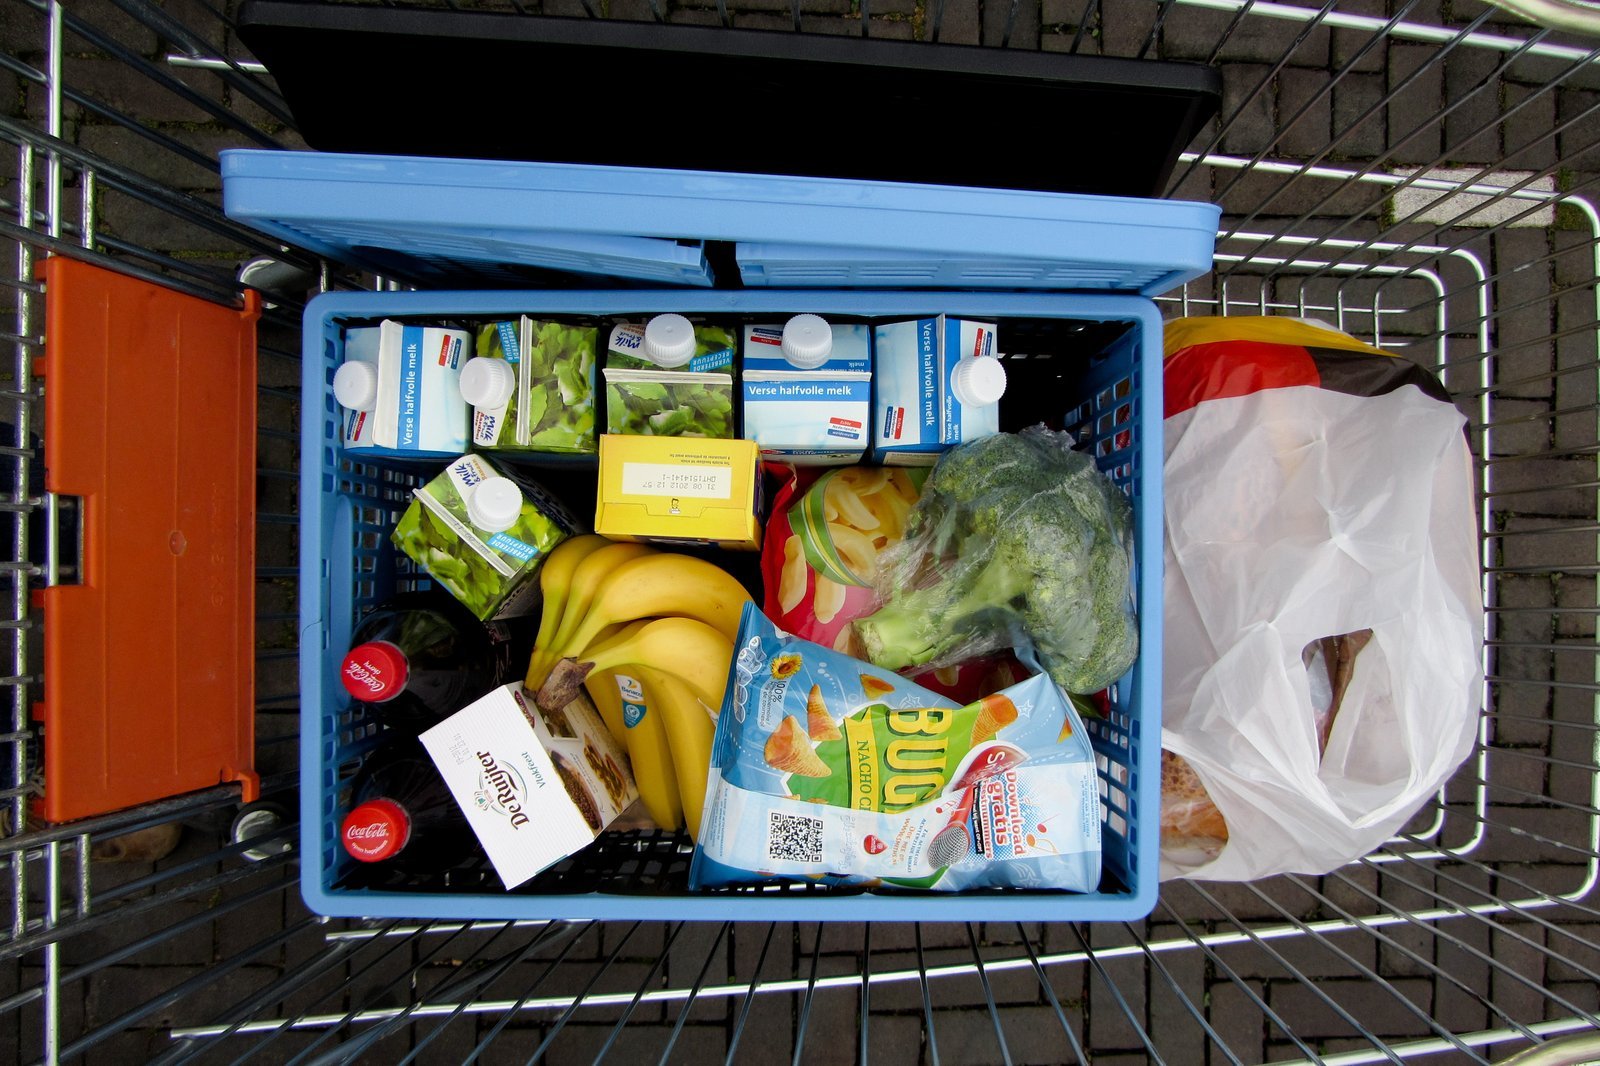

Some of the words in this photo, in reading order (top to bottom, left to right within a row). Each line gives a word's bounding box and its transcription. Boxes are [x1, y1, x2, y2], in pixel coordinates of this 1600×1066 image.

[500, 324, 513, 361] RECEPTUUR
[505, 323, 520, 360] VERBETERDE
[614, 336, 640, 349] Milk
[619, 331, 637, 340] fruit
[923, 323, 931, 352] Verse
[408, 343, 416, 371] melk
[692, 352, 730, 365] RECEPTUUR
[693, 358, 730, 372] VERBETERDE
[924, 353, 934, 396] halfvolle
[405, 372, 416, 414] halfvolle
[749, 386, 777, 396] Verse
[780, 386, 823, 396] halfvolle
[826, 386, 852, 396] melk
[926, 398, 934, 426] melk
[403, 416, 414, 445] Verse
[484, 416, 495, 440] Milk
[454, 462, 475, 488] Milk
[465, 462, 478, 478] fruit
[490, 539, 530, 561] VERBETERDE
[496, 534, 534, 555] RECEPTUUR
[363, 660, 382, 676] cherry
[773, 680, 786, 703] 100%
[477, 751, 518, 809] Ruijter
[521, 752, 546, 788] Vlokfeest
[856, 740, 872, 796] NACHO
[508, 804, 530, 830] De
[987, 781, 1007, 846] gratis
[1004, 772, 1025, 855] Download
